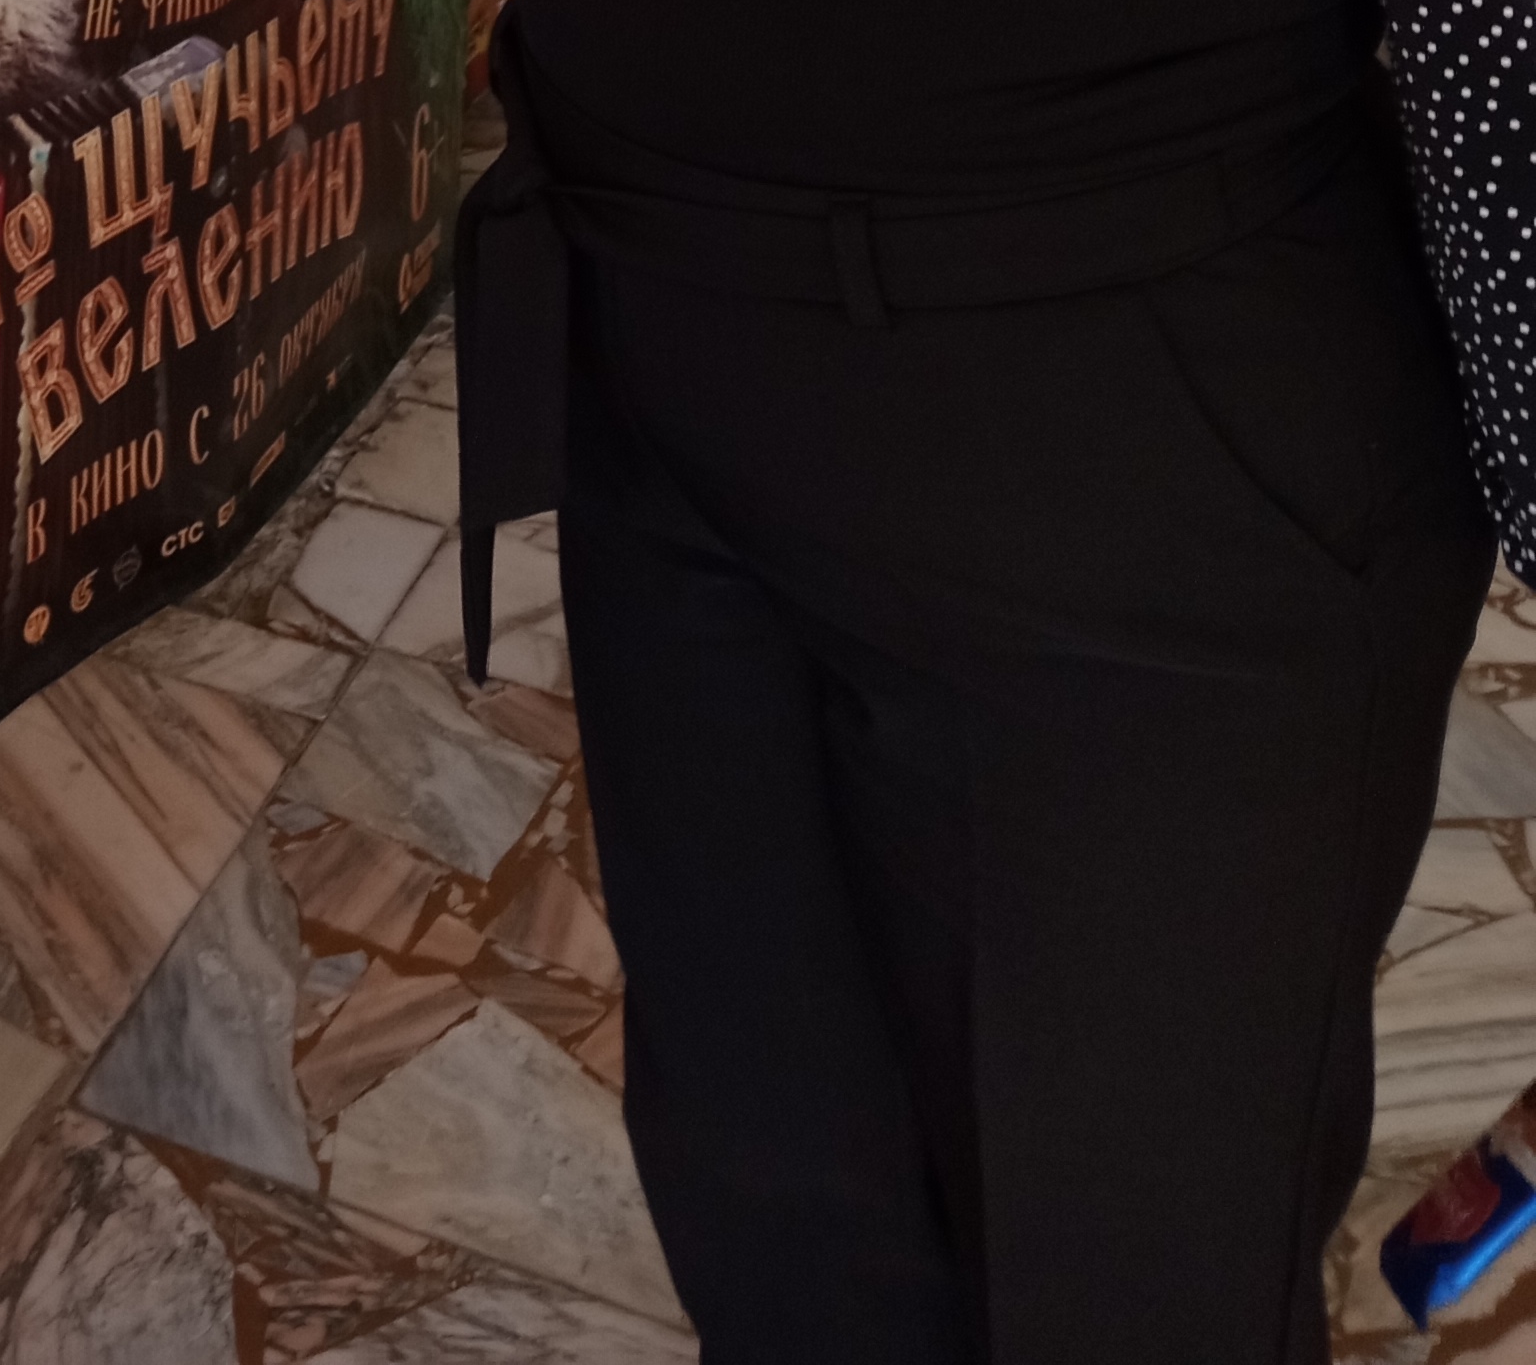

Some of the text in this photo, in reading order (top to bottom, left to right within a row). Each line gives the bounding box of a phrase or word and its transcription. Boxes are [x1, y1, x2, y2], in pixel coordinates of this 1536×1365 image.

[26, 497, 47, 565] В
[70, 428, 165, 536] КИНО
[189, 404, 210, 466] С
[232, 351, 266, 442] 26
[161, 520, 206, 558] СТС
